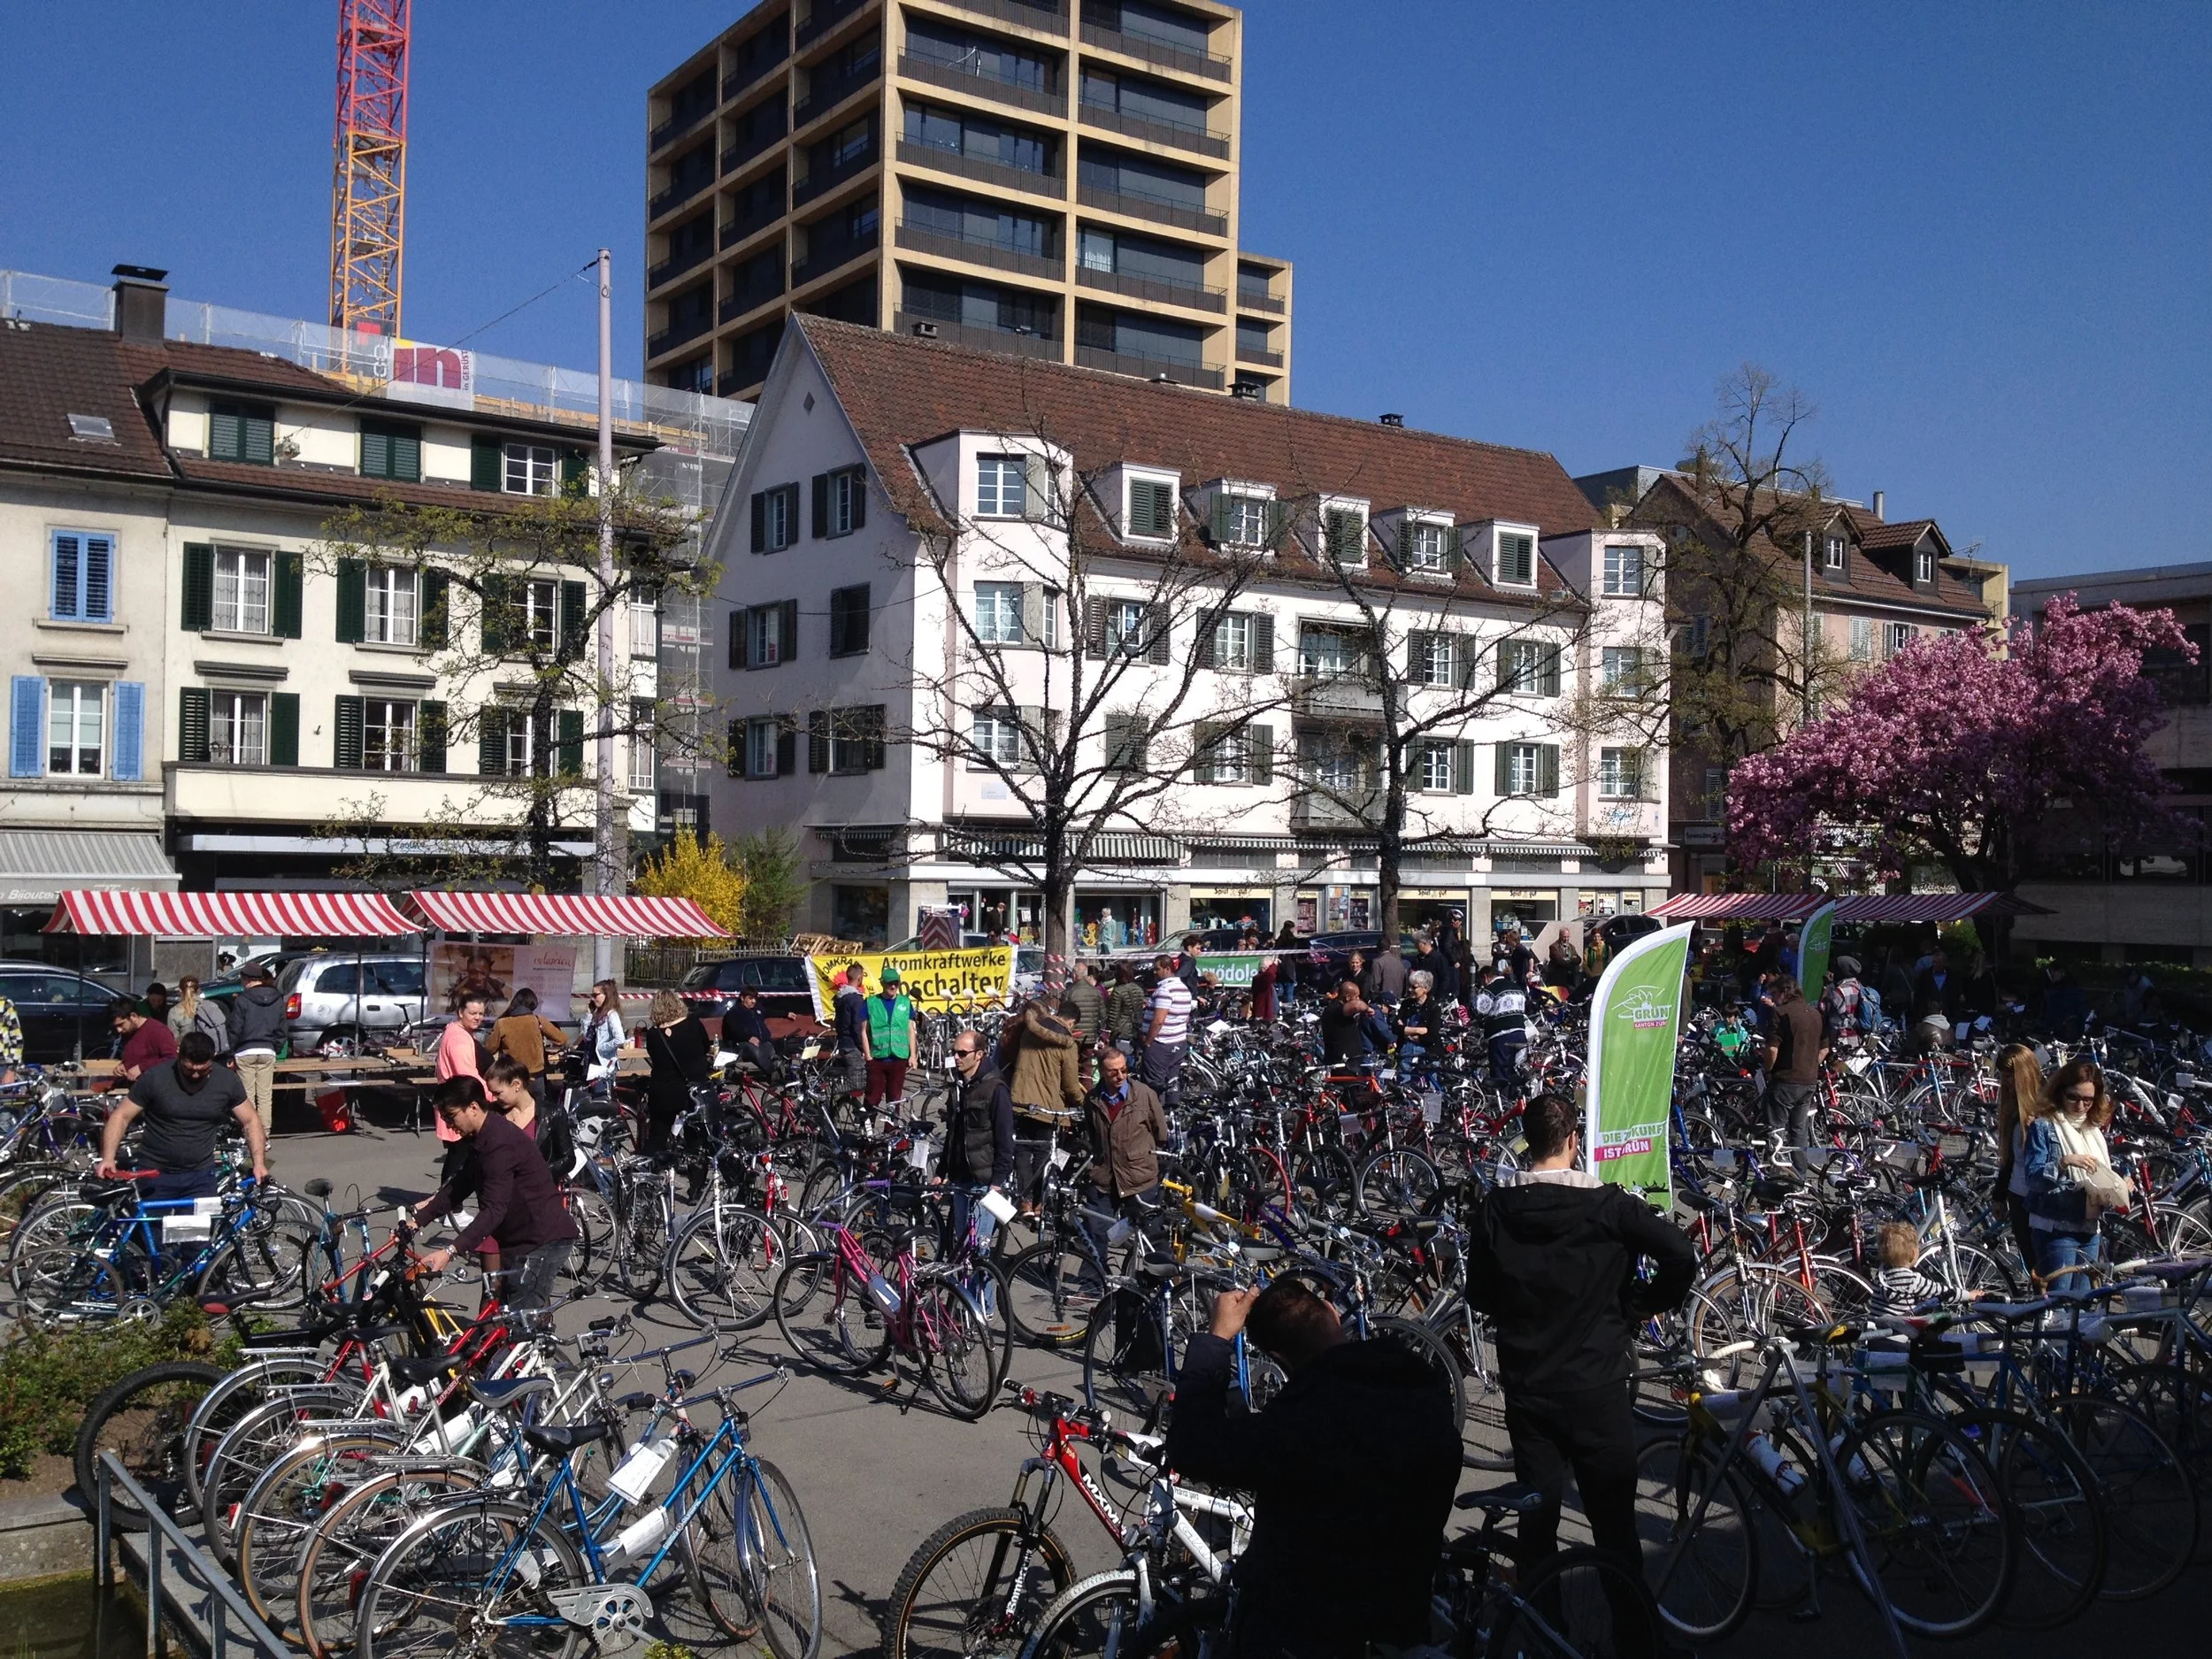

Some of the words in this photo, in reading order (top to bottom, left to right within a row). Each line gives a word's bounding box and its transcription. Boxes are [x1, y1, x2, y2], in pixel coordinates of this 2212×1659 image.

[882, 952, 1006, 972] Atomkraftwerke
[1602, 1133, 1622, 1143] DIE
[1603, 1147, 1622, 1159] IST
[1622, 1140, 1649, 1154] RÜN
